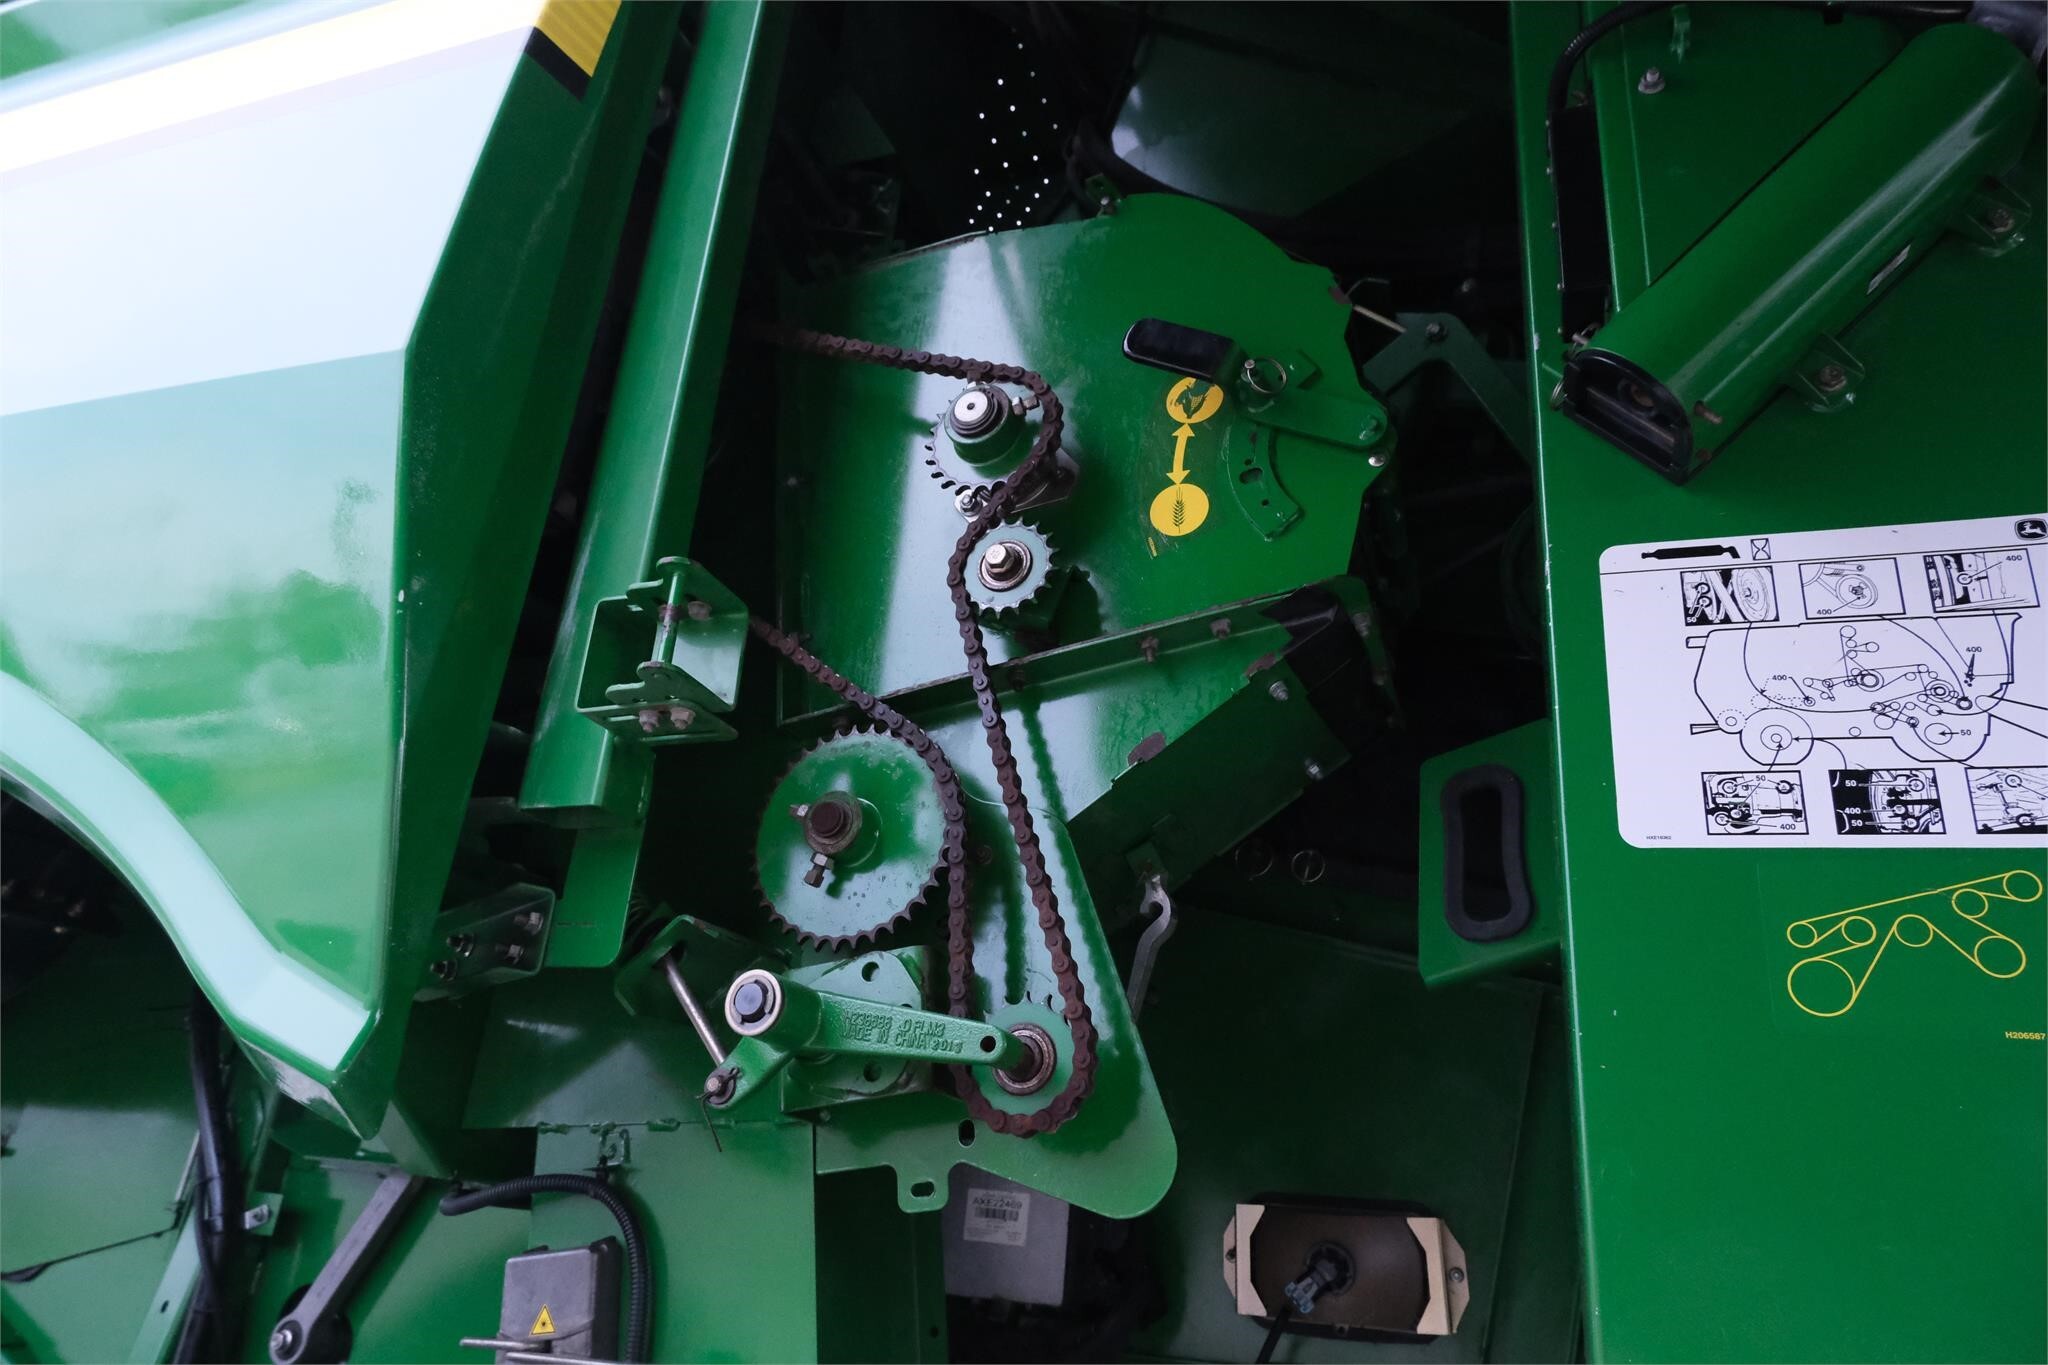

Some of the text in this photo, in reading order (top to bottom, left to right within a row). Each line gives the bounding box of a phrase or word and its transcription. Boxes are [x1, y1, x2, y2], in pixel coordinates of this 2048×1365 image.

[1686, 616, 1697, 624] 50
[1961, 729, 1972, 737] 50
[1755, 774, 1766, 782] 50
[1851, 819, 1863, 827] 50
[840, 1023, 873, 1042] MADE
[877, 1029, 890, 1045] IN
[894, 1032, 927, 1050] CHINA
[2005, 1031, 2046, 1040] H206587
